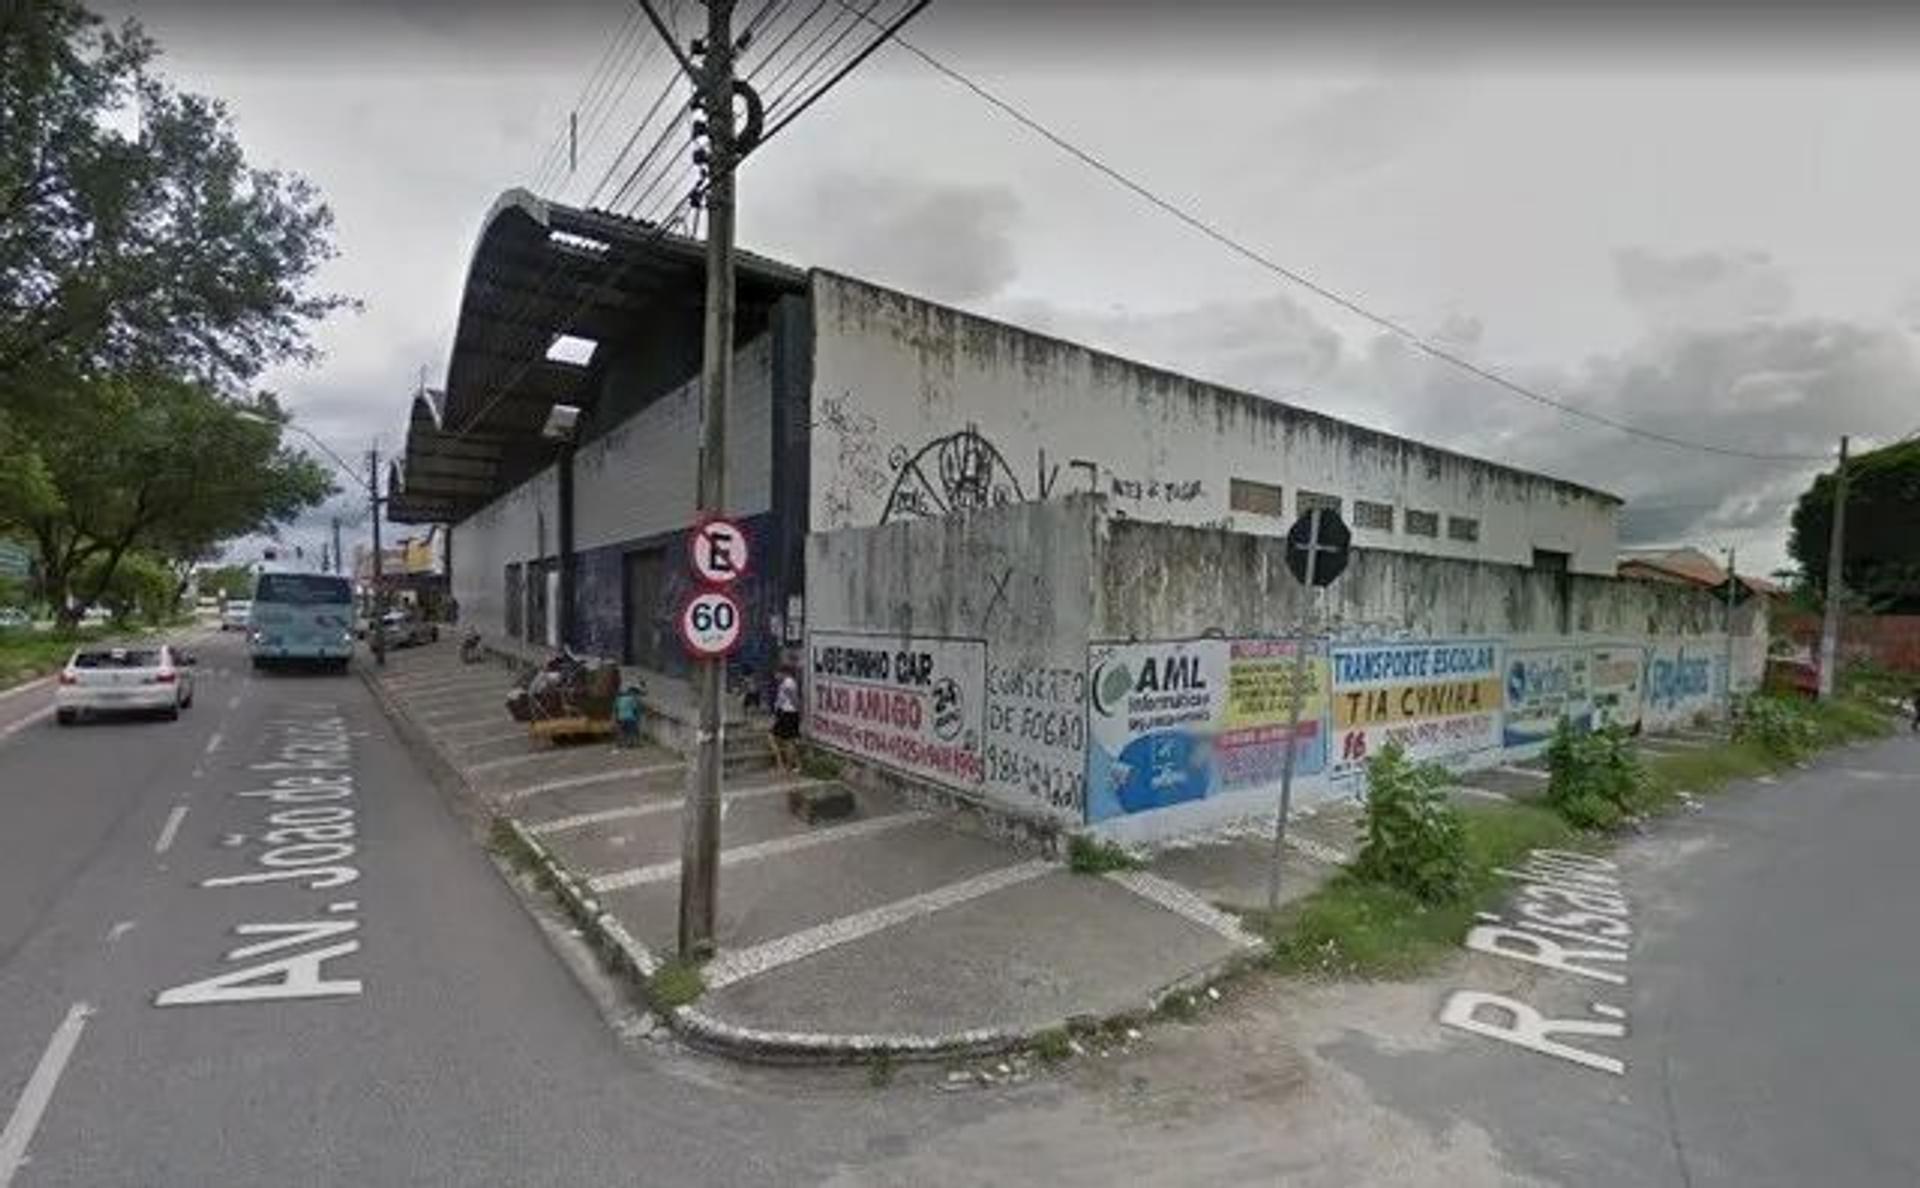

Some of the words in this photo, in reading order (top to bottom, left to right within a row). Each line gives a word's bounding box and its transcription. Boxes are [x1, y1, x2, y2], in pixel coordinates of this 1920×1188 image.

[709, 532, 732, 571] E
[692, 602, 734, 631] 60
[1135, 655, 1206, 692] AML
[1334, 650, 1430, 684] TRANSPORTE
[1433, 644, 1494, 674] ESCOLAR
[855, 687, 923, 732] AMIGO
[989, 705, 1015, 733] DE
[1347, 689, 1388, 725] TIA
